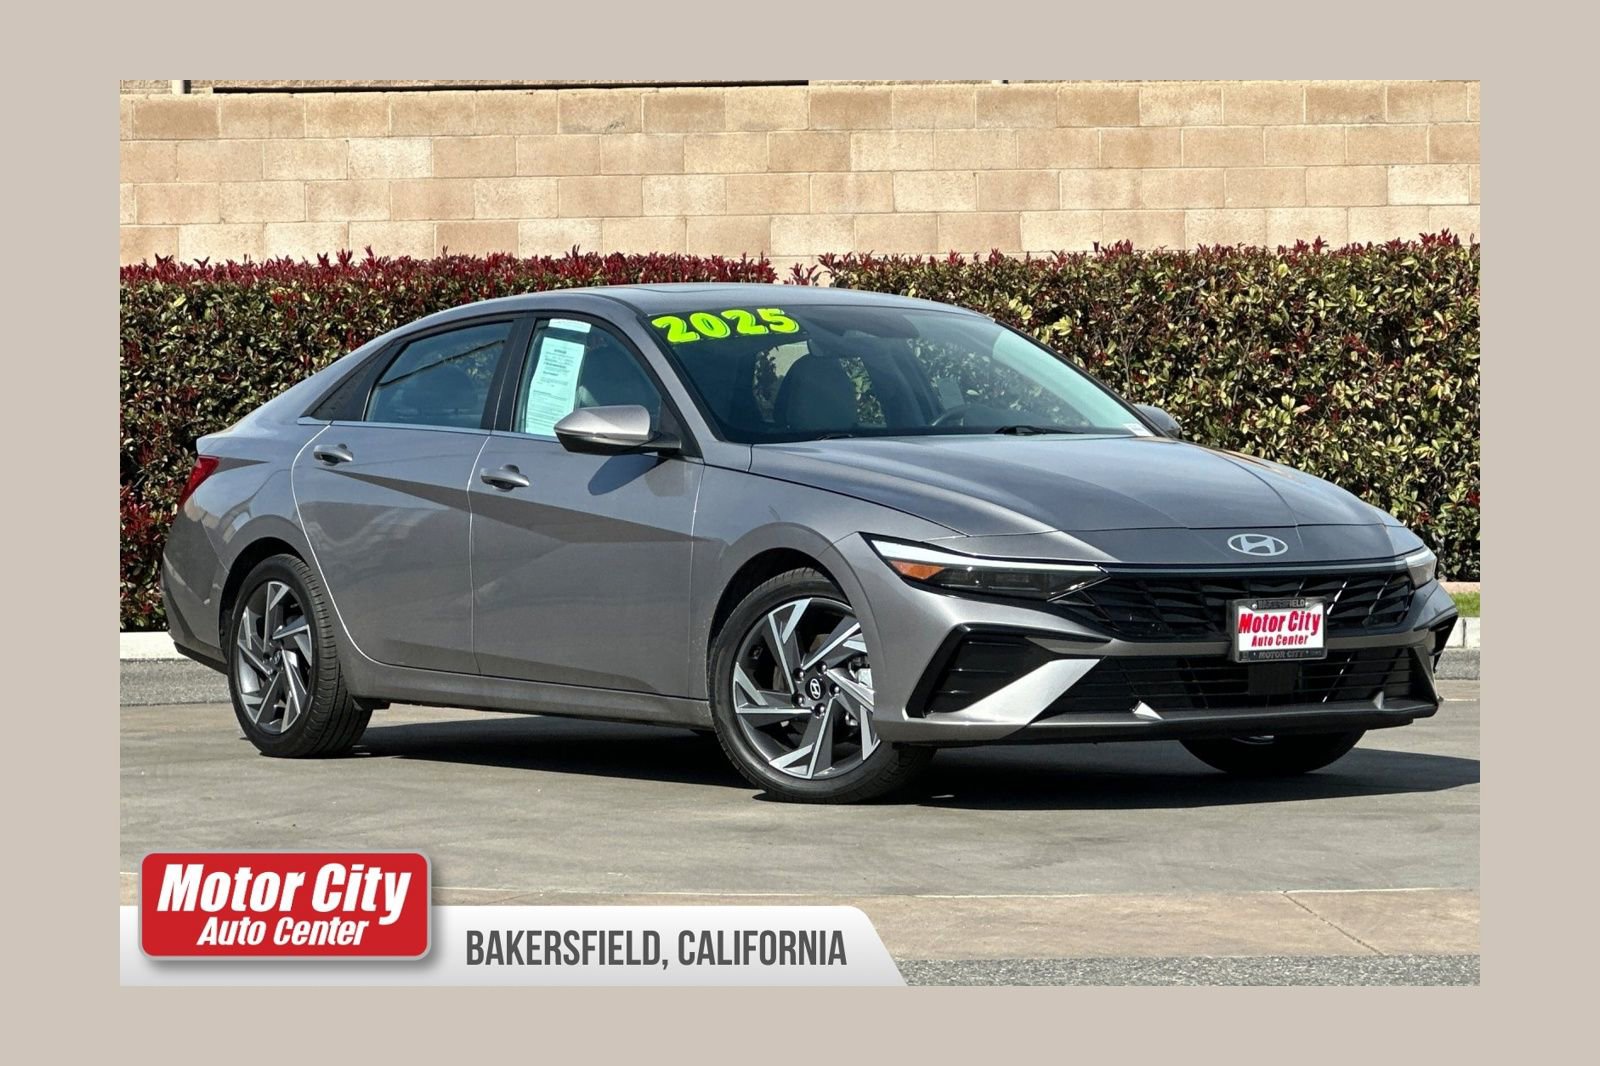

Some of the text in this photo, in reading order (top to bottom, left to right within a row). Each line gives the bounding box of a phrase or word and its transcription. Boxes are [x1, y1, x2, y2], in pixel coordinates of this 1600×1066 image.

[651, 308, 800, 343] 2025
[1238, 610, 1321, 636] Motor City
[1251, 634, 1309, 647] Auto Center
